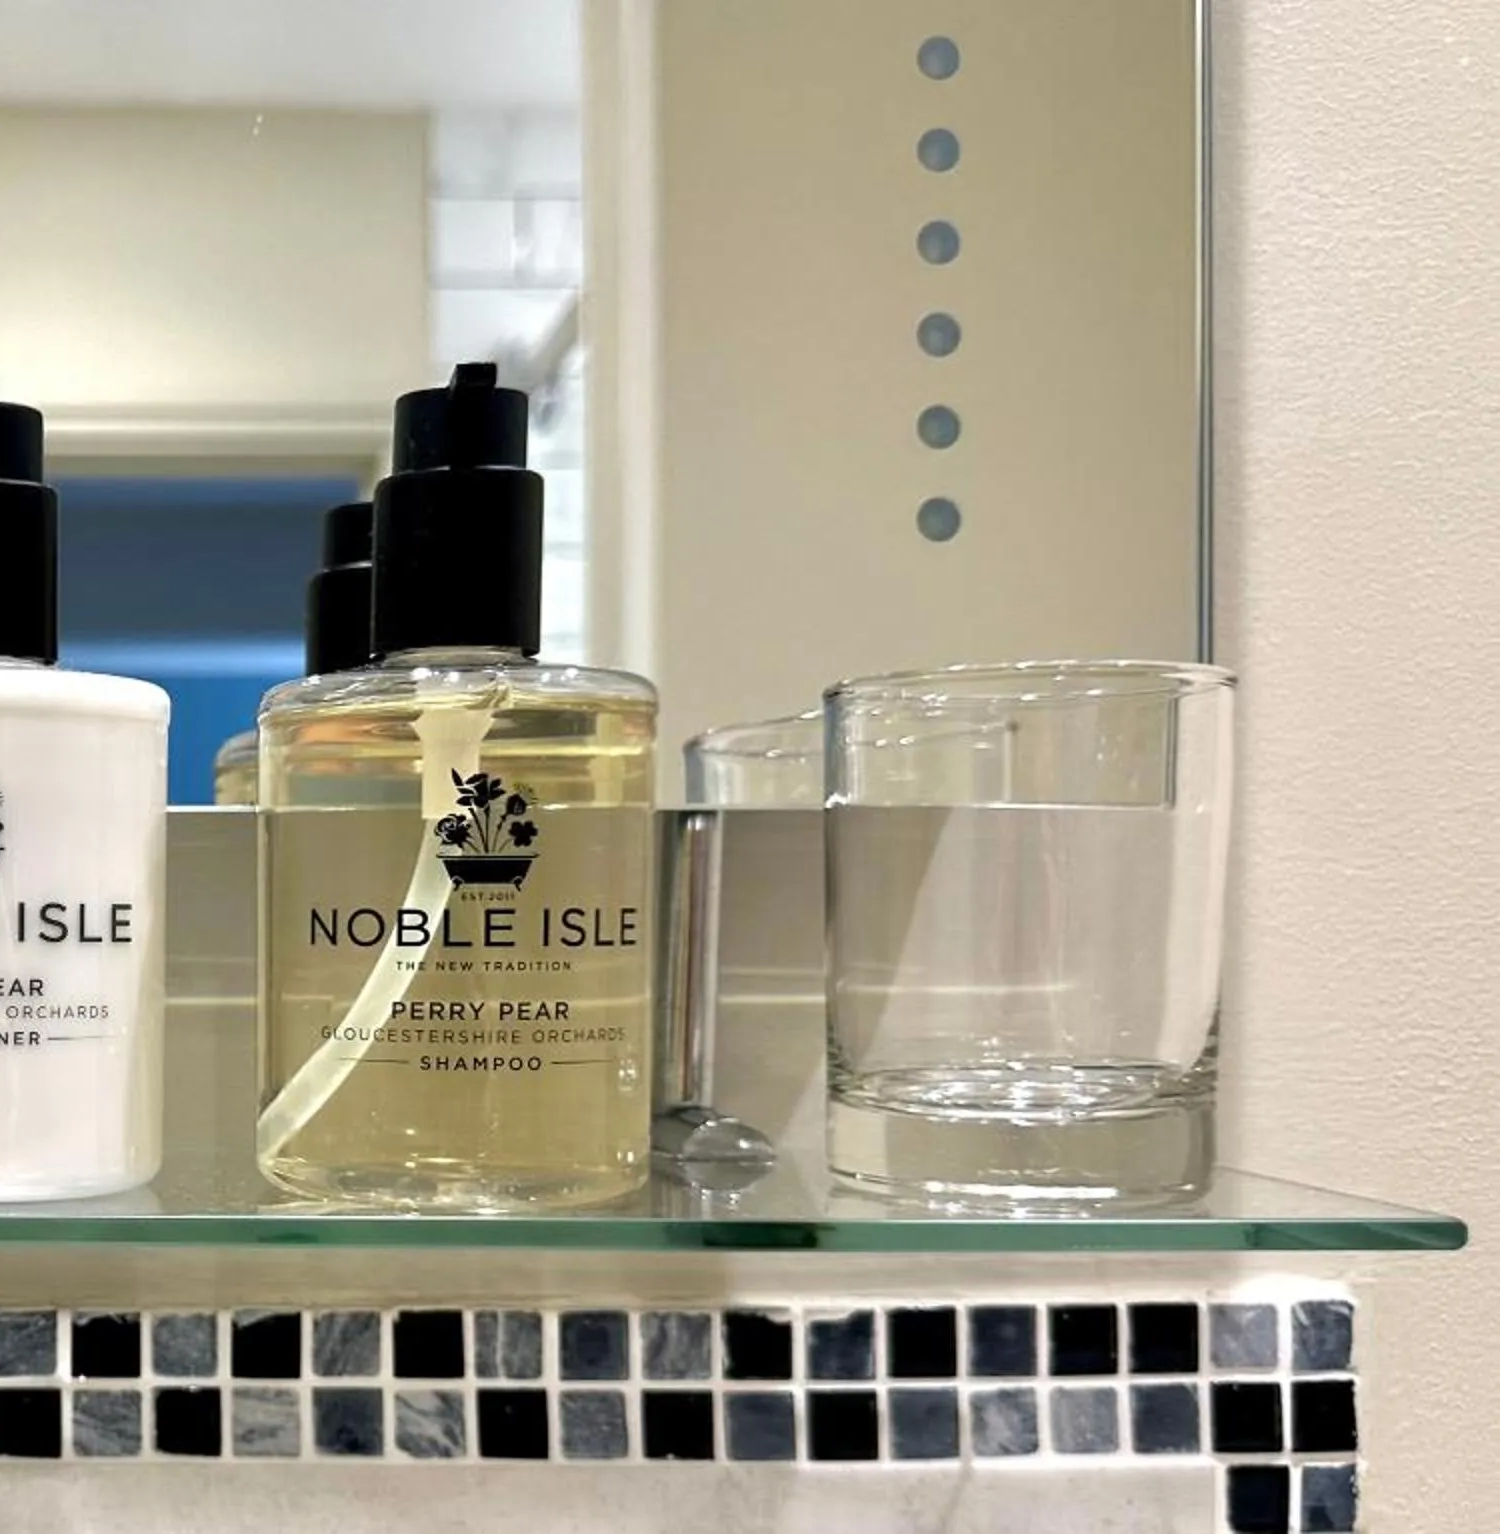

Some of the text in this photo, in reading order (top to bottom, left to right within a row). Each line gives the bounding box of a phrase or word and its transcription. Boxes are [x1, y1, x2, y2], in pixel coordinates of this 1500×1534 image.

[18, 901, 133, 944] ISLE
[310, 908, 638, 948] NOBLE ISLE
[396, 960, 572, 972] THE NEW TRADITION
[6, 1004, 109, 1020] ORCHARDS
[391, 1001, 570, 1022] PERRY PEAR
[320, 1026, 626, 1045] GLOUCESTERSHIRE ORCHARDS
[420, 1055, 543, 1072] SHAMPOO
